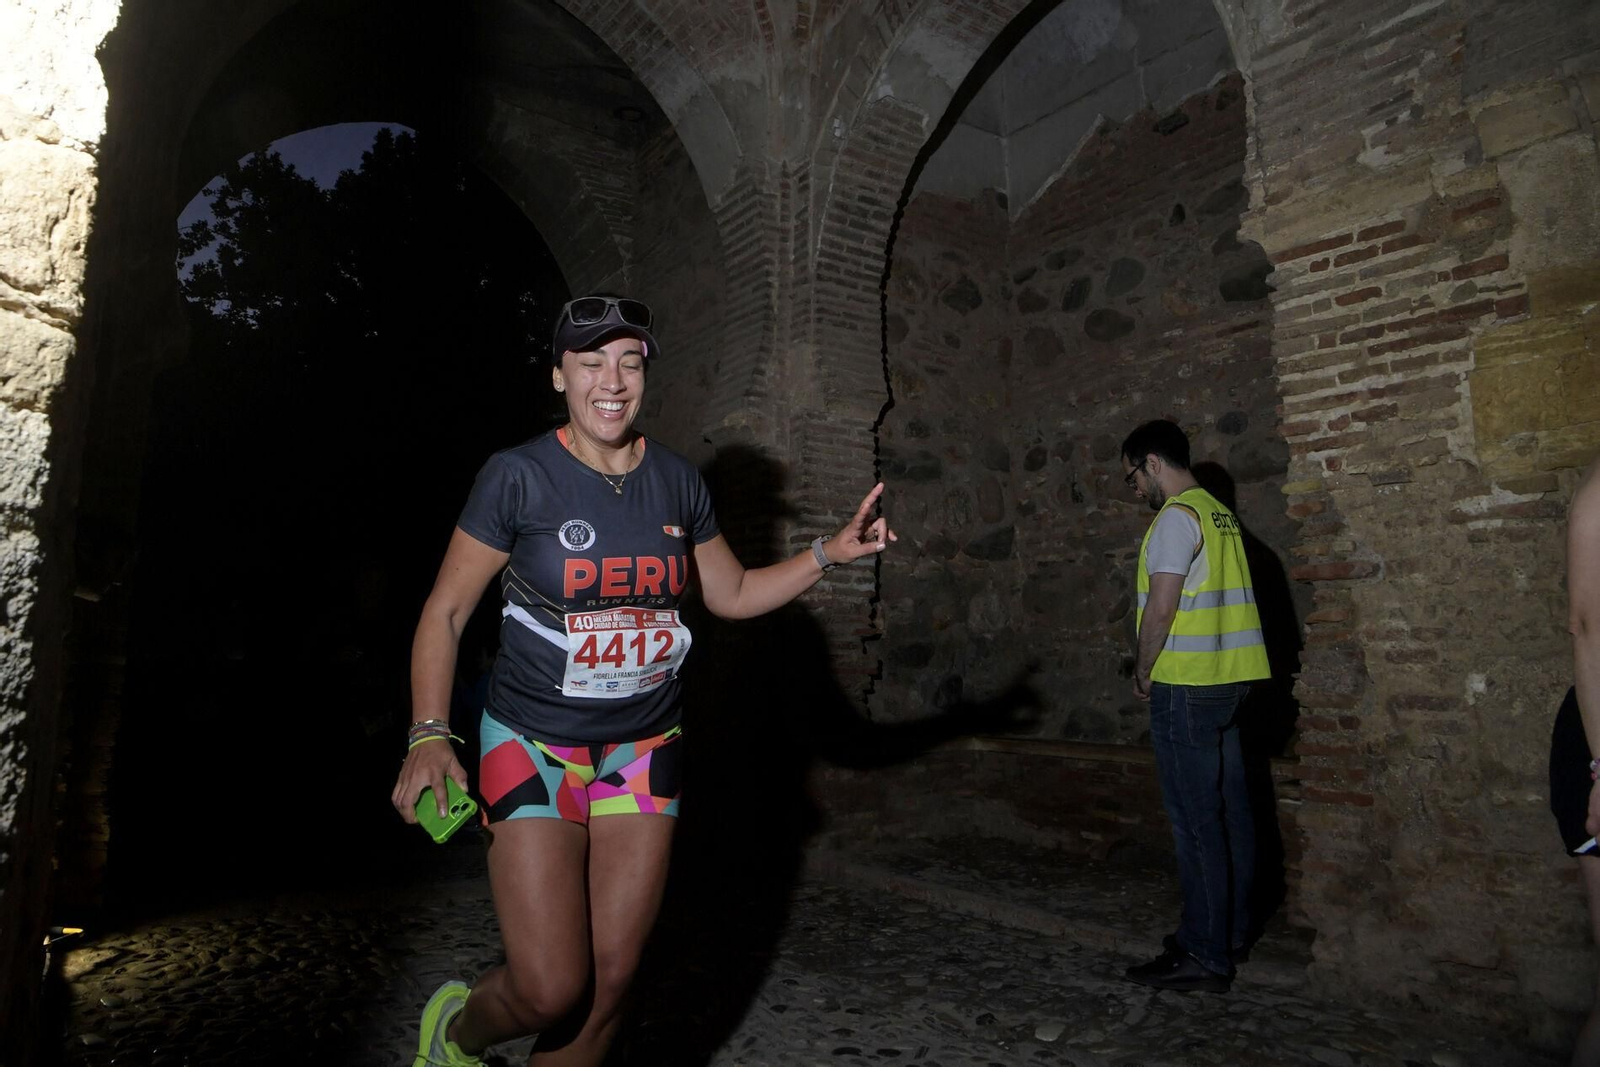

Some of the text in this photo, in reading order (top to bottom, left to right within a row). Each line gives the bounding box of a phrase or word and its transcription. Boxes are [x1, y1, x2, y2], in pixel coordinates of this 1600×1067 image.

[563, 555, 688, 599] PERU
[573, 615, 594, 630] 40
[593, 614, 613, 623] MEDIA
[573, 629, 675, 669] 4412
[593, 672, 617, 680] FIORELLA
[617, 671, 638, 679] FRANCIA
